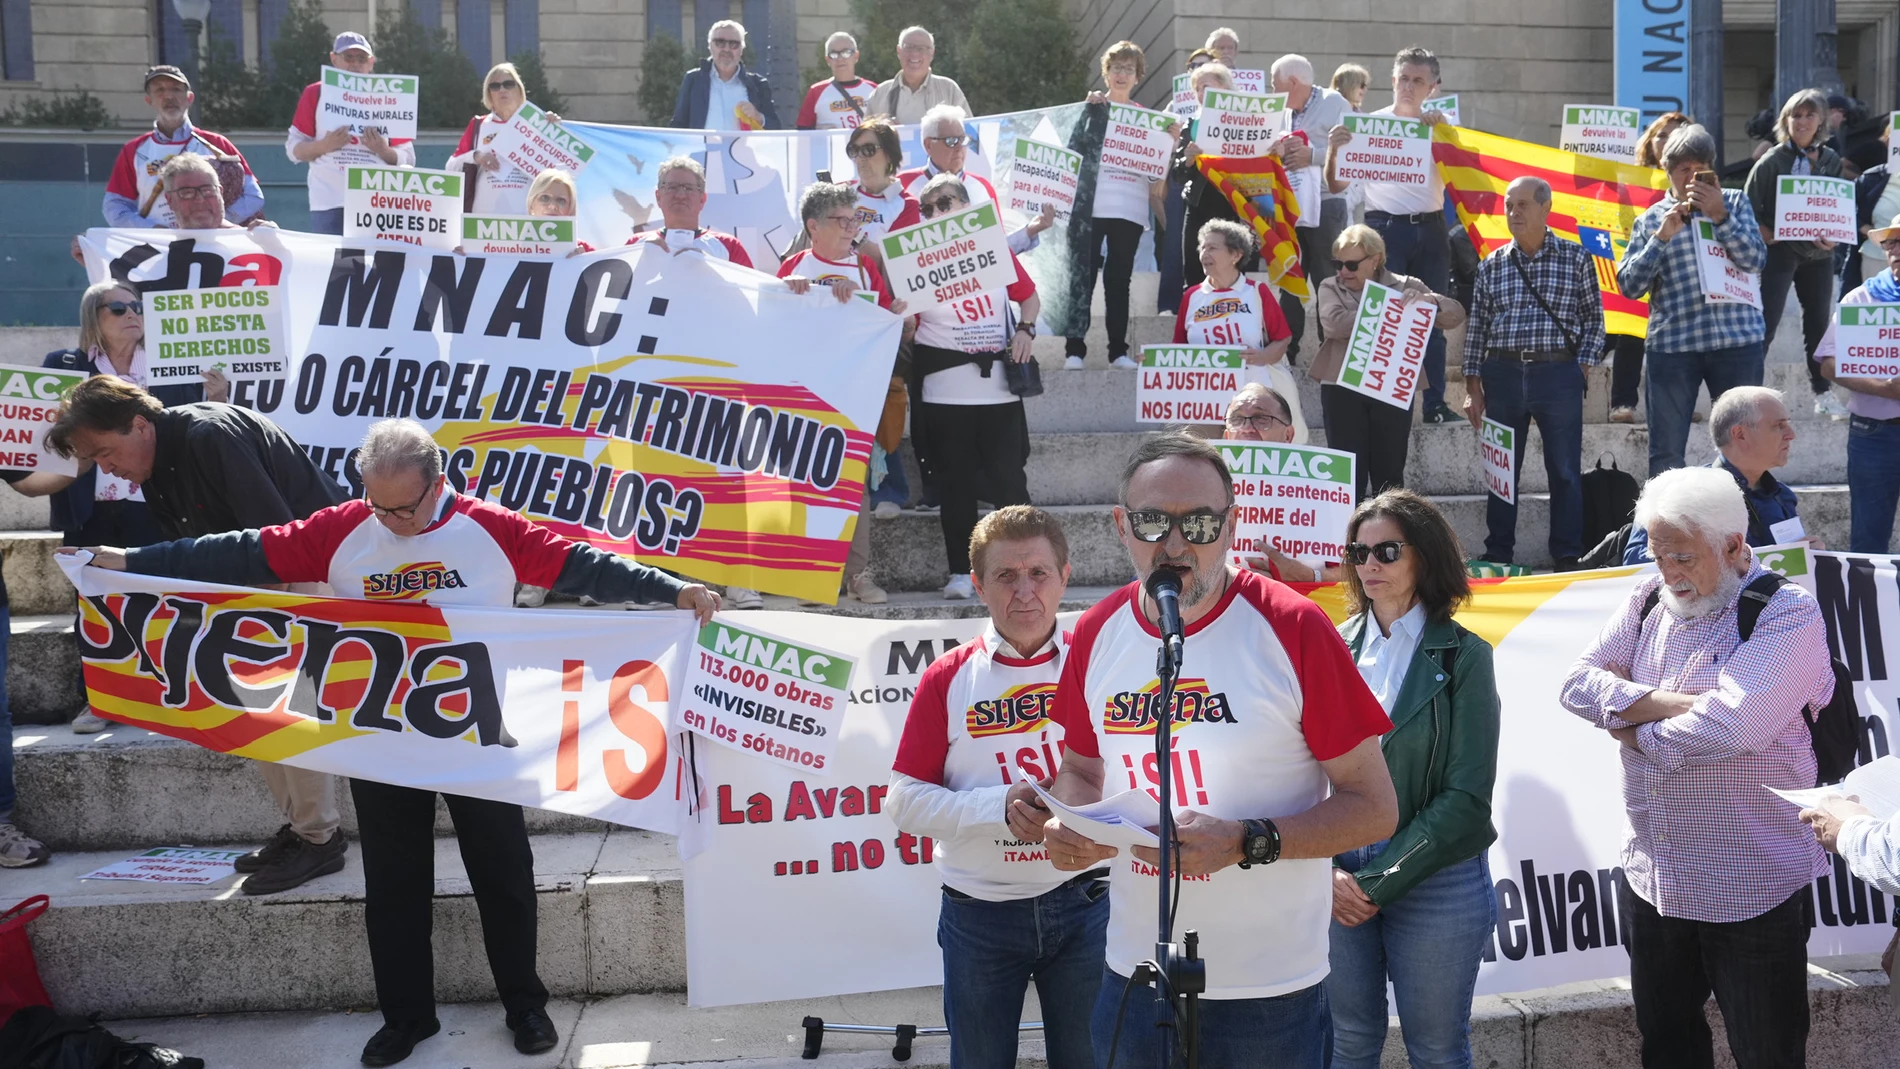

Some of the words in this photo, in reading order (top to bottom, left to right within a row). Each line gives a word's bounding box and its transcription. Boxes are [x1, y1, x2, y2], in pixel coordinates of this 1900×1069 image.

[337, 73, 404, 92] MNAC
[342, 92, 382, 105] devuelve
[385, 96, 397, 105] las
[1214, 92, 1276, 113] MNAC
[325, 103, 370, 120] PINTURAS
[372, 110, 414, 120] MURALES
[1220, 112, 1265, 126] devuelve
[1578, 108, 1632, 128] MNAC
[528, 111, 585, 157] MNAC
[1114, 125, 1148, 140] PIERDE
[1208, 126, 1220, 138] LO
[1222, 128, 1244, 142] QUE
[1246, 130, 1259, 140] ES
[1260, 129, 1272, 140] DE
[1356, 118, 1419, 138] MNAC
[1582, 126, 1616, 138] devuelve
[1618, 129, 1626, 139] las
[514, 121, 534, 138] LOS
[532, 136, 578, 170] RECURSOS
[1221, 143, 1255, 156] SIJENA
[1368, 138, 1403, 150] PIERDE
[1564, 143, 1606, 154] PINTURAS
[1608, 144, 1635, 156] MURALES
[520, 143, 536, 158] NO
[534, 155, 556, 169] DAN
[1026, 142, 1079, 173] MNAC
[1158, 150, 1164, 160] Y
[1345, 152, 1414, 168] CREDIBILIDAD
[1416, 158, 1422, 168] Y
[1014, 158, 1060, 182] incapacidad
[1339, 168, 1426, 184] RECONOCIMIENTO
[360, 170, 445, 194] MNAC
[1014, 180, 1031, 192] para
[1033, 184, 1040, 194] el
[1793, 180, 1848, 198] MNAC
[370, 192, 432, 212] devuelve
[1011, 198, 1025, 209] por
[1026, 200, 1039, 212] tus
[1806, 197, 1838, 208] PIERDE
[356, 212, 372, 228] LO
[376, 214, 404, 232] QUE
[408, 216, 424, 232] ES
[428, 218, 447, 234] DE
[1784, 212, 1846, 224] CREDIBILIDAD
[1847, 216, 1852, 225] Y
[476, 220, 558, 242] MNAC
[898, 212, 983, 255] MNAC
[1778, 227, 1855, 241] RECONOCIMIENTO
[917, 240, 976, 268] devuelve
[1707, 245, 1725, 258] LOS
[906, 274, 926, 292] LO
[928, 264, 958, 288] QUE
[958, 257, 976, 276] ES
[978, 250, 998, 270] DE
[1724, 266, 1736, 278] NO
[934, 277, 982, 303] SIJENA
[1724, 282, 1754, 303] RAZONES
[153, 294, 194, 312] SER
[201, 290, 270, 309] POCOS
[161, 318, 189, 336] NO
[196, 314, 266, 333] RESTA
[1203, 318, 1242, 345] ¡SÍ!
[1347, 296, 1384, 373] MNAC
[1372, 298, 1405, 368] JUSTICIA
[1402, 306, 1433, 366] IGUALA
[158, 338, 272, 359] DERECHOS
[1155, 350, 1230, 368] MNAC
[232, 362, 282, 373] EXISTE
[0, 372, 62, 400] AC
[1144, 372, 1162, 390] LA
[1166, 372, 1237, 391] JUSTICIA
[1364, 370, 1387, 392] LA
[1392, 366, 1416, 403] NOS
[294, 354, 327, 414] O
[332, 346, 483, 420] CÁRCEL
[496, 366, 580, 430] DEL
[570, 376, 847, 489] PATRIMONIO
[1142, 402, 1172, 420] NOS
[0, 428, 33, 444] AN
[1222, 448, 1333, 480] MNAC
[474, 448, 703, 556] PUEBLOS?
[1260, 480, 1272, 496] la
[1277, 485, 1350, 505] sentencia
[1290, 508, 1316, 527] del
[714, 626, 831, 684] MNAC
[700, 652, 770, 692] 113.000
[774, 680, 834, 711] obras
[694, 684, 828, 738] «INVISIBLES»
[684, 708, 706, 730] en
[710, 716, 738, 743] los
[742, 732, 826, 770] sótanos
[717, 784, 773, 825] La
[832, 838, 885, 873] no
